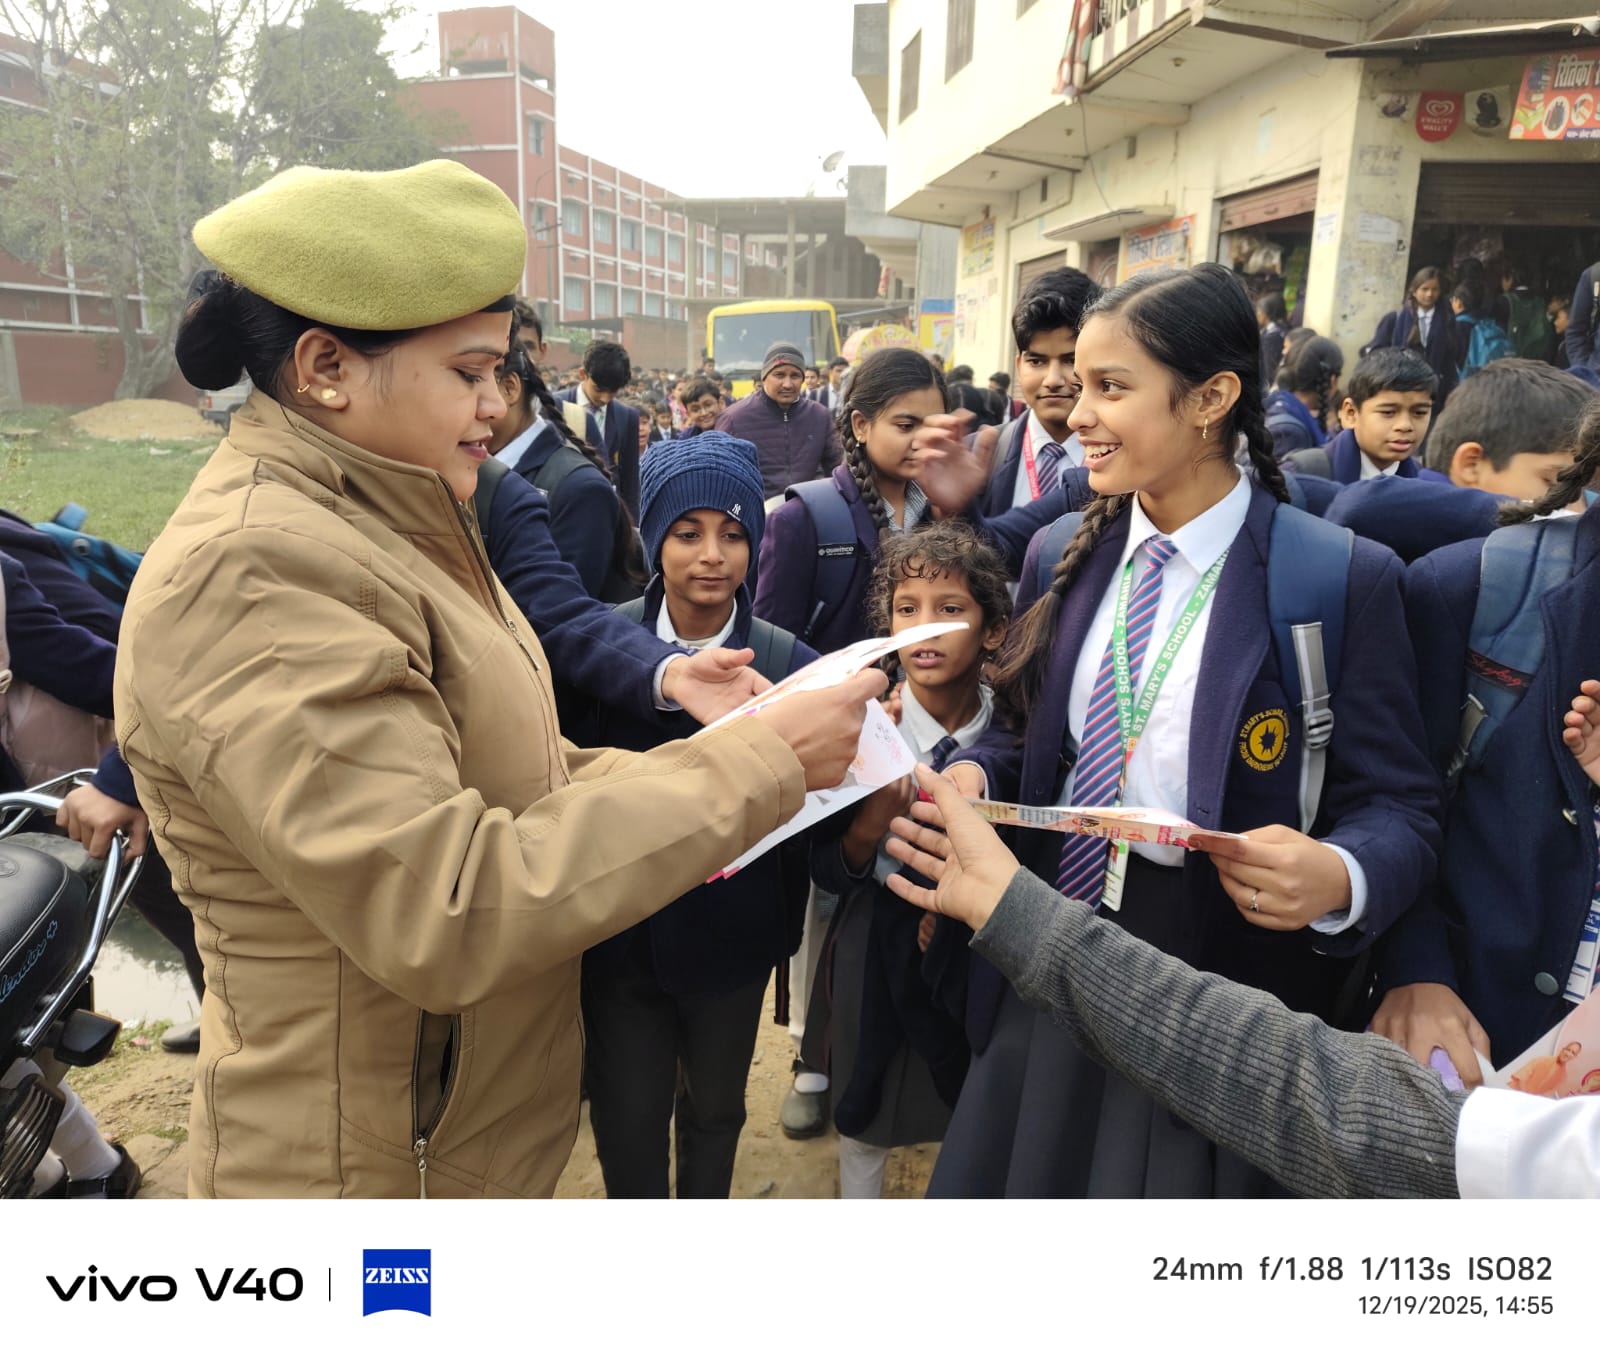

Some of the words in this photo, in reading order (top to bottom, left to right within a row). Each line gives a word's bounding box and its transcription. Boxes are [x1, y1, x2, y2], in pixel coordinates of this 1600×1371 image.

[1116, 575, 1132, 627] ZAMANIA
[1115, 639, 1129, 694] SCHOOL
[1133, 710, 1147, 733] ST.
[1141, 664, 1166, 712] MARY'S
[1162, 610, 1197, 659] SCHOOL
